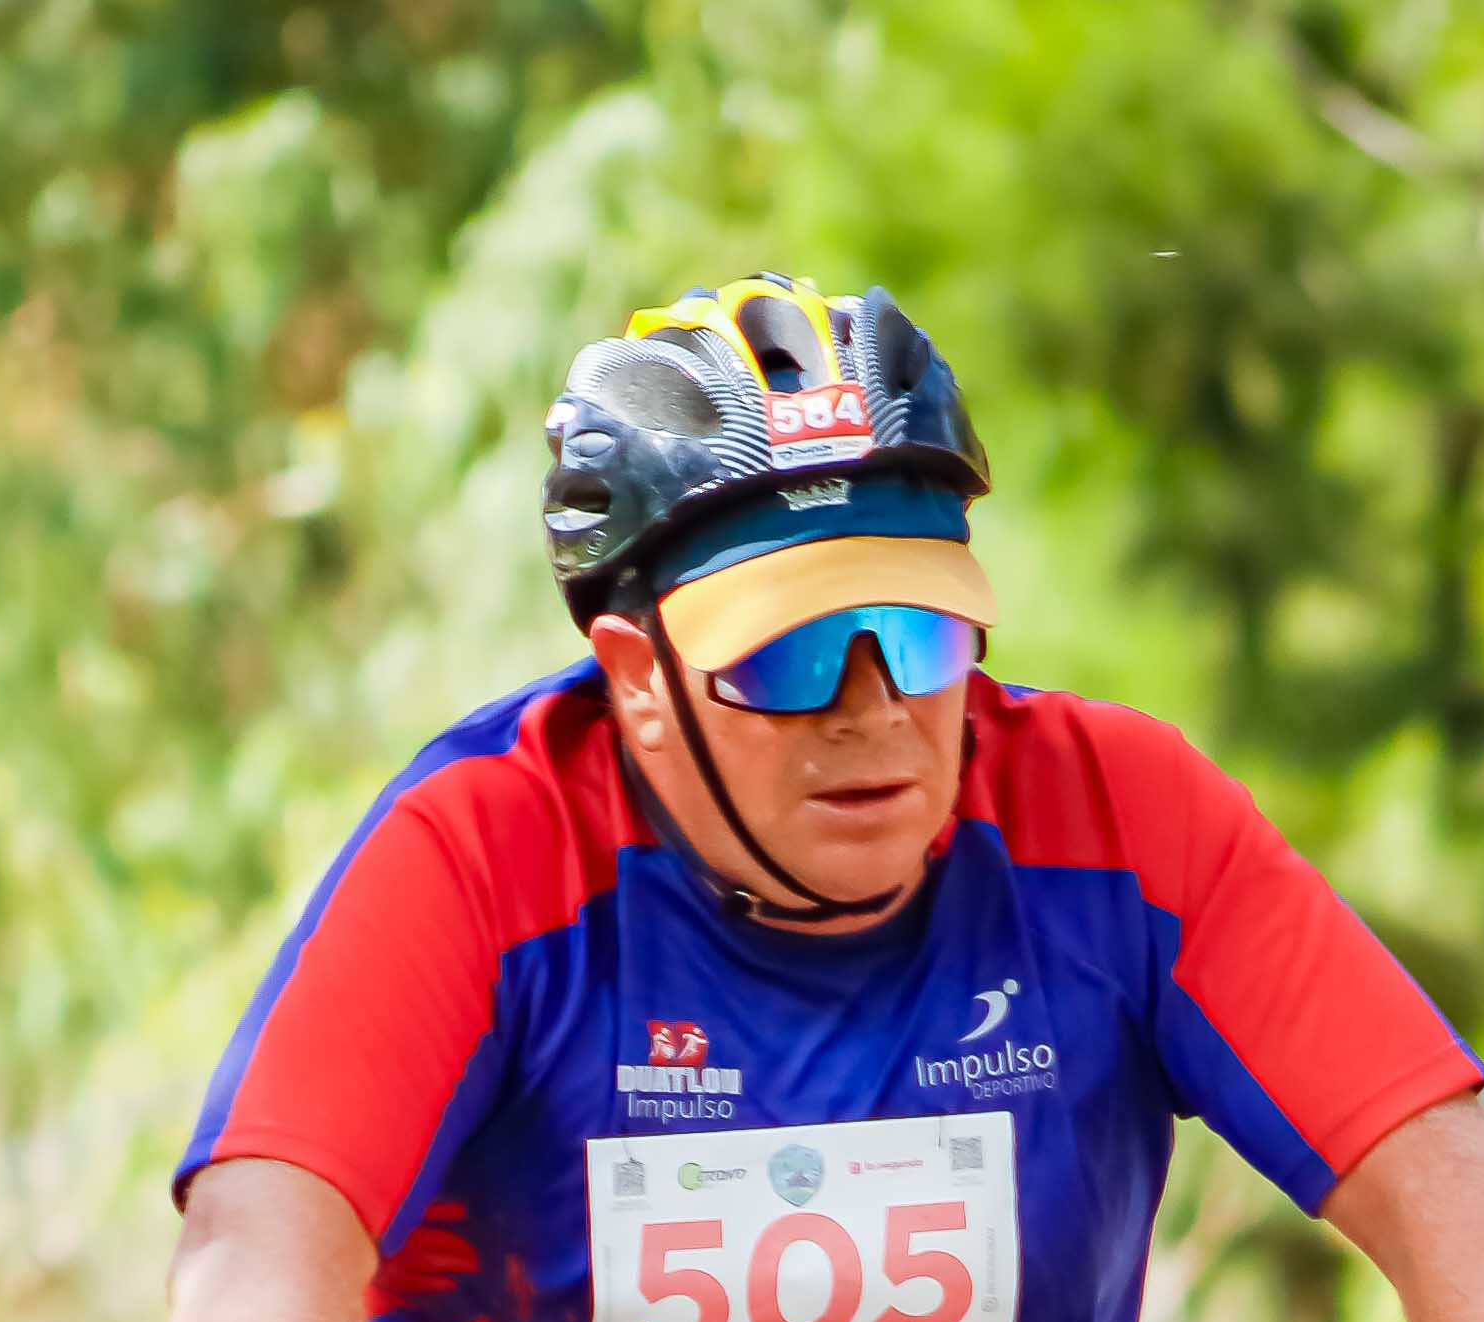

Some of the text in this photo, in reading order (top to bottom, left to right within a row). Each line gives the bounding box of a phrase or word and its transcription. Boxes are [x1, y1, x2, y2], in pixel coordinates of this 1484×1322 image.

[915, 1040, 1054, 1088] Impulso
[972, 1071, 1055, 1100] DEPORTIVO
[628, 1092, 734, 1124] Impulso
